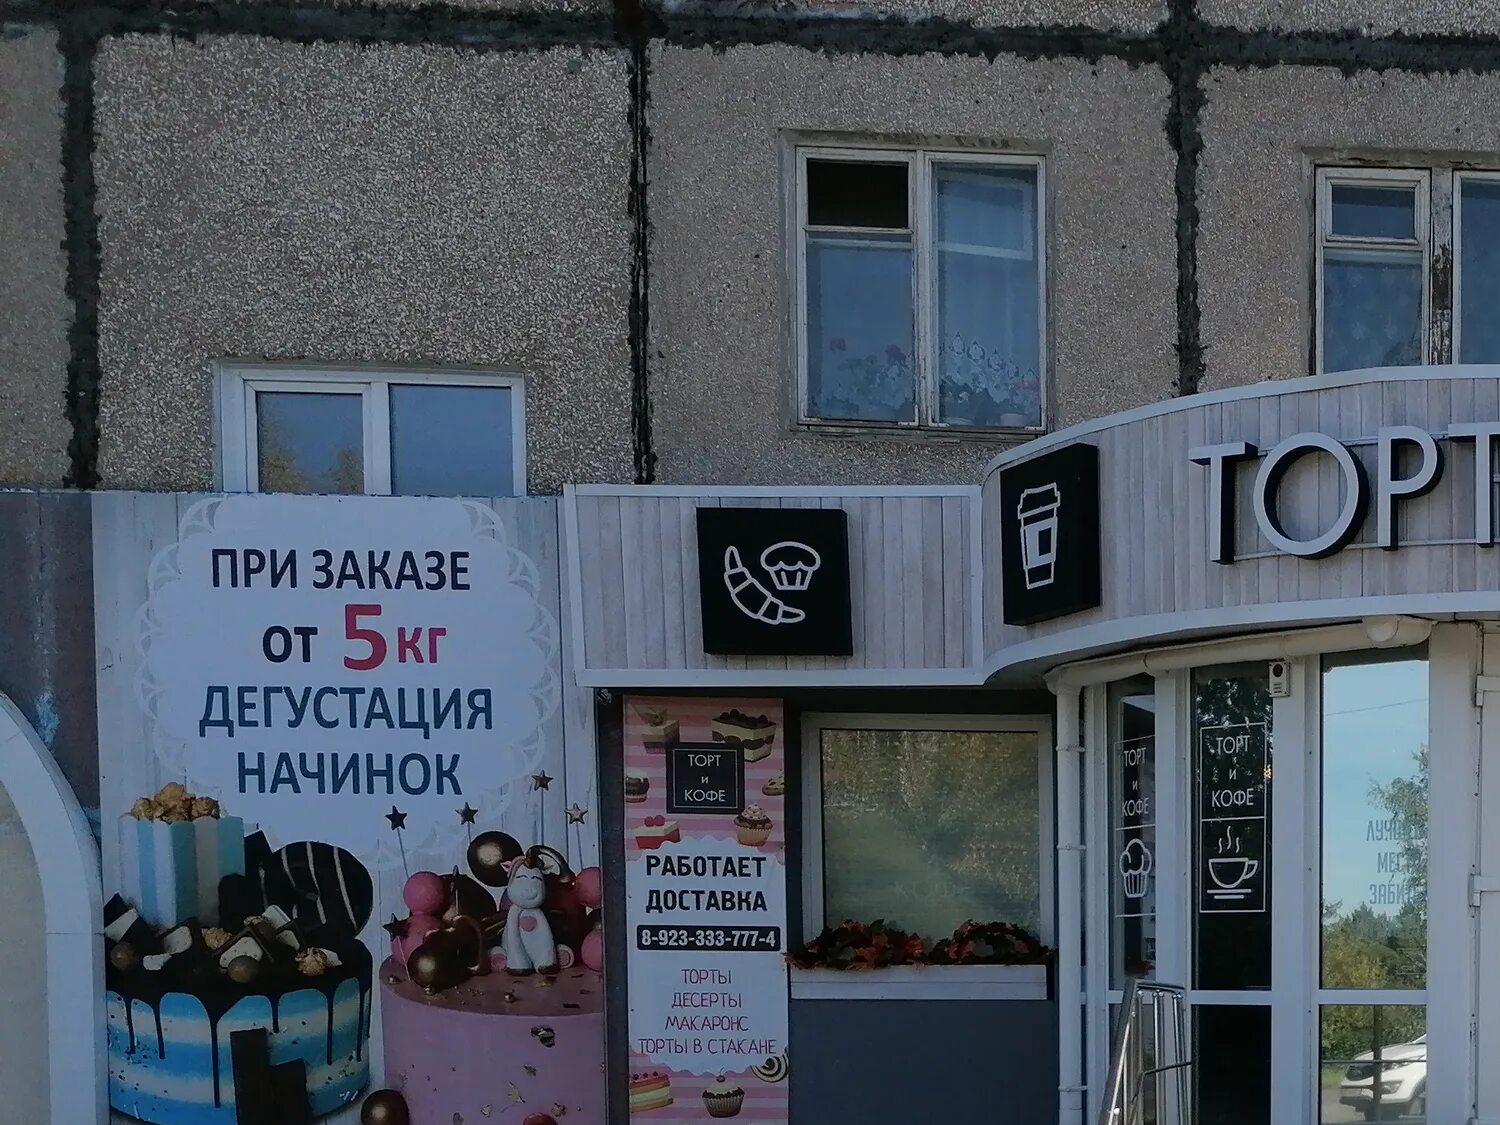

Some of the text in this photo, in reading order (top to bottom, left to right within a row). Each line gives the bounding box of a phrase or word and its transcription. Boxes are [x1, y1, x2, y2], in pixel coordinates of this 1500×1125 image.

[211, 548, 471, 591] ПРИ ЗАКАЗЕ
[200, 685, 493, 738] ДЕГУСТАЦИЯ
[1216, 735, 1250, 756] ТОРТ
[688, 754, 721, 767] ТОРТ
[1123, 747, 1147, 767] ТОРТ
[237, 751, 462, 796] НАЧИНОК
[684, 789, 726, 802] КОФЕ
[1211, 789, 1254, 808] КОФЕ
[1121, 797, 1150, 817] КОФЕ
[646, 855, 766, 878] РАБОТАЕТ
[645, 889, 768, 914] ДОСТАВКА
[641, 929, 776, 947] 8-923-333-777-4
[681, 968, 732, 985] ТОРТЫ
[672, 992, 742, 1009] ДЕСЕРТЫ
[665, 1015, 750, 1032] МАКАРОНС
[638, 1038, 777, 1056] ТОРТЫ В СТАКАНЕ
